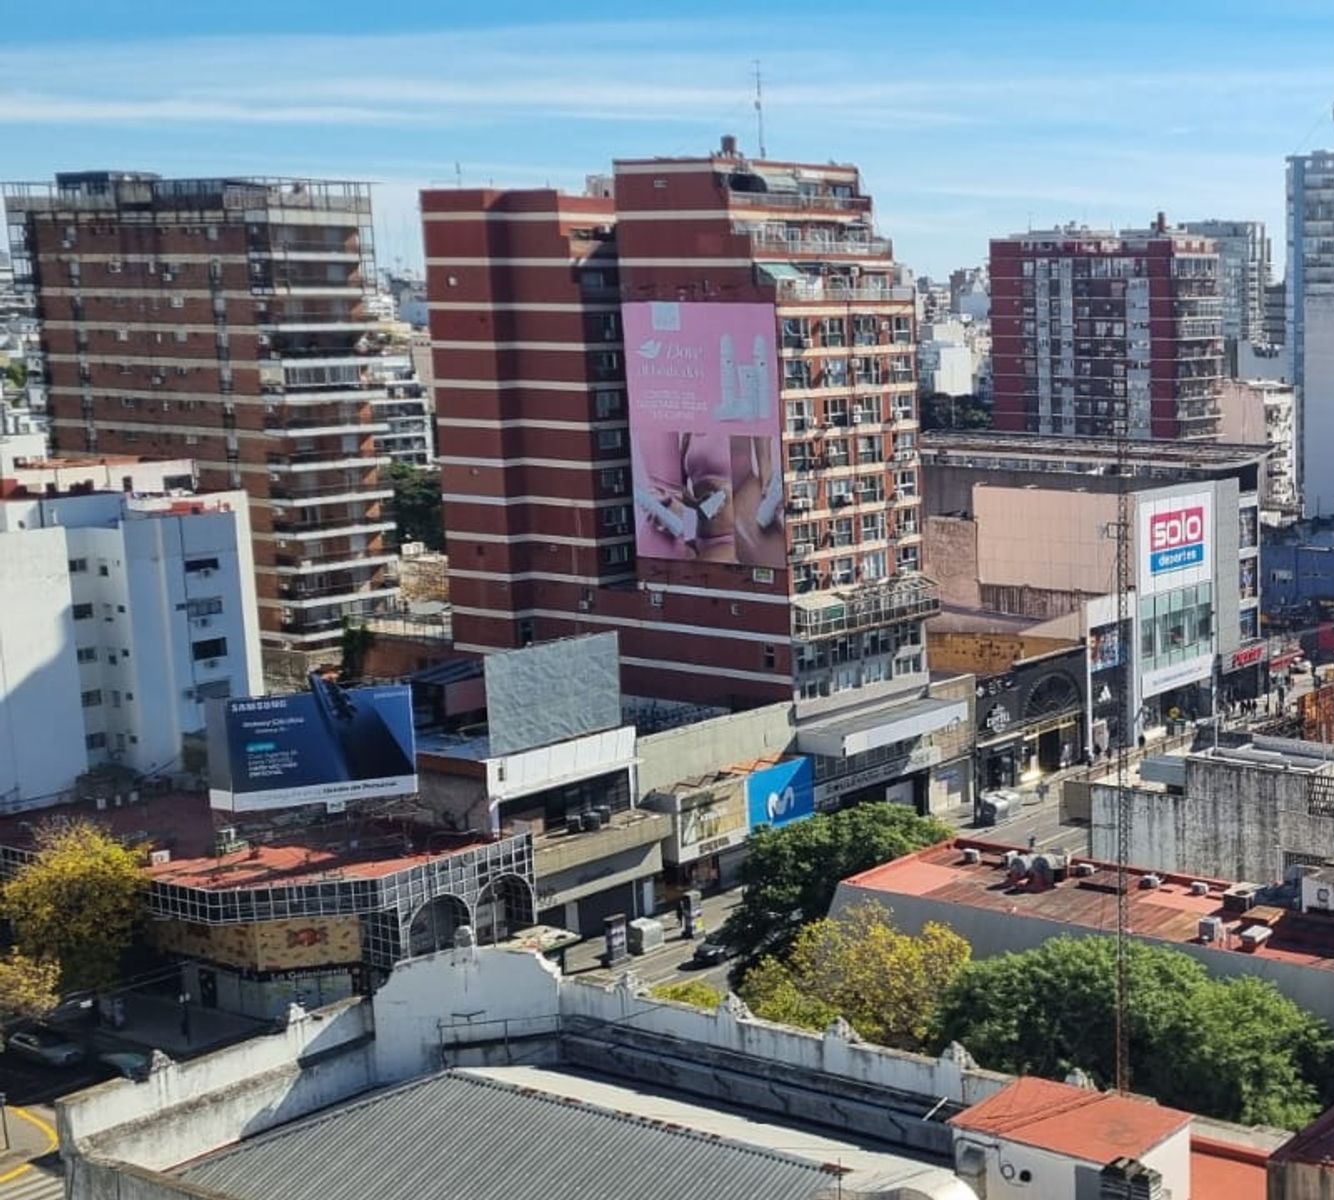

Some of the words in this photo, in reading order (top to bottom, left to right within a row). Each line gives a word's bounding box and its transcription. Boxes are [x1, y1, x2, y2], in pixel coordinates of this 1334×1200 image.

[1154, 511, 1201, 548] solo
[1159, 550, 1197, 567] deportes
[231, 700, 287, 713] SAMSUNG
